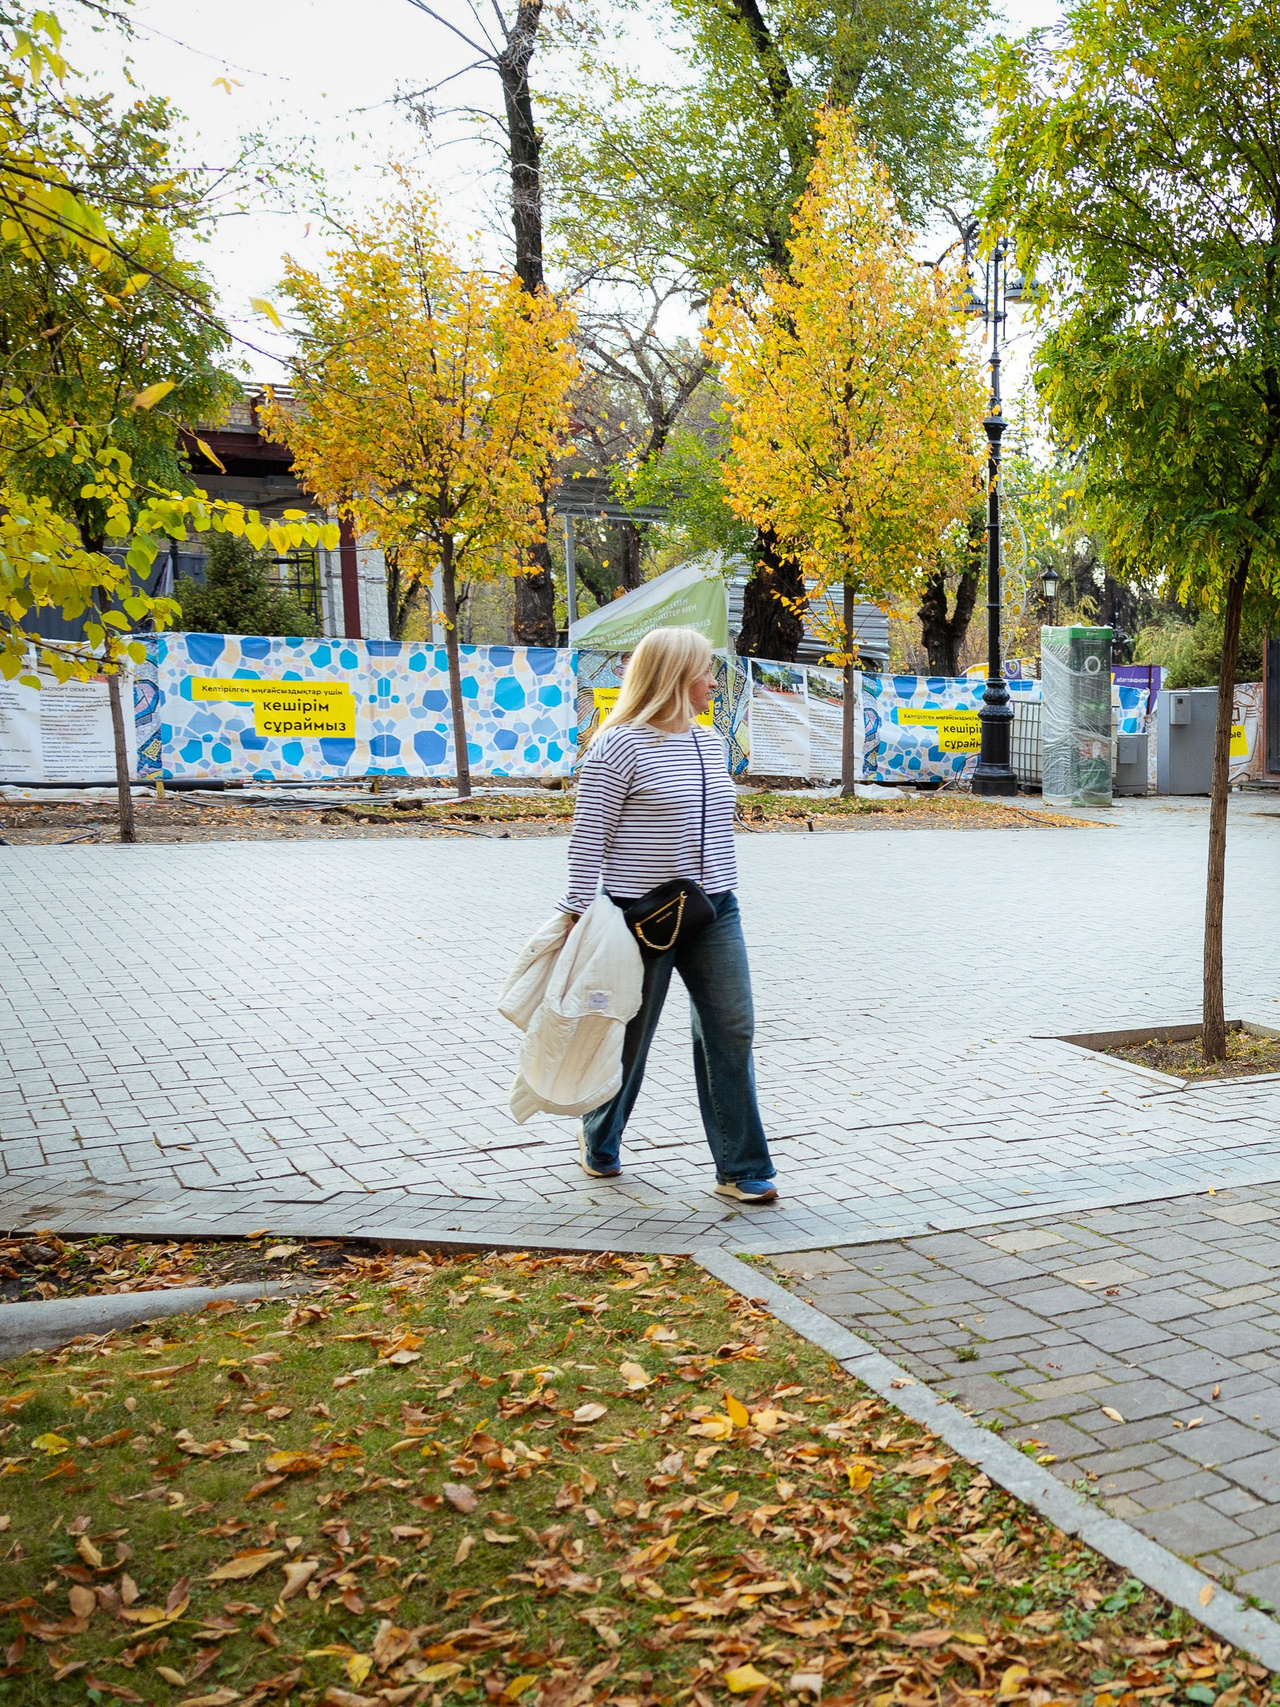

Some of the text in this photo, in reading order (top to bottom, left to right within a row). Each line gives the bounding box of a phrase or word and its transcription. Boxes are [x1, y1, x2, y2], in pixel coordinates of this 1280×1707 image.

[202, 685, 250, 693] Келтірілген
[263, 698, 330, 714] кешірім
[263, 717, 347, 734] сұраймыз
[943, 723, 981, 736] кешірі
